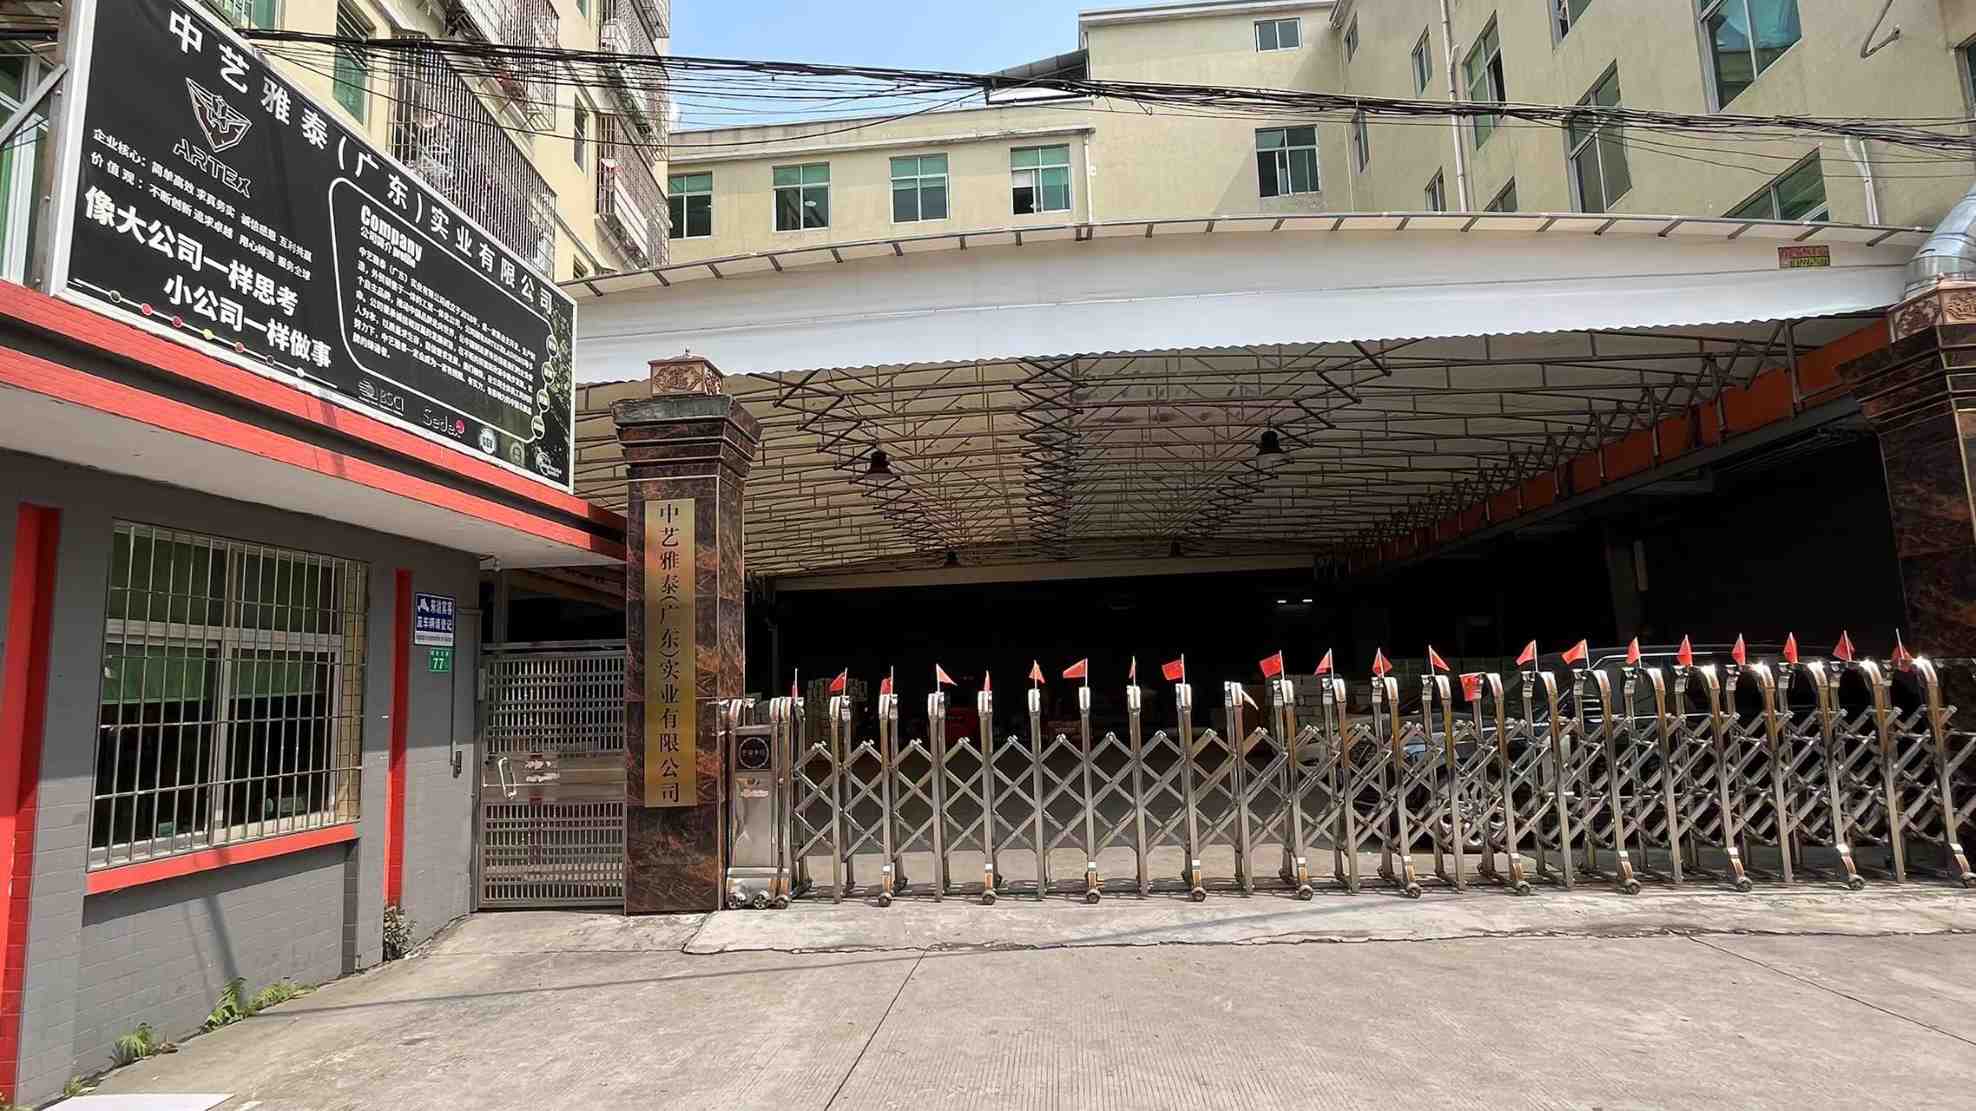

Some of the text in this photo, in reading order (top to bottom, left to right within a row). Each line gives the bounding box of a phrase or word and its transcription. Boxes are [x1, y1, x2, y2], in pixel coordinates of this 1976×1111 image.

[169, 10, 552, 314] 中艺雅泰（广东）实业有限公司
[85, 185, 298, 316] 像大公司一样思考
[361, 204, 422, 262] Company
[163, 275, 332, 368] 小公司一样做事
[432, 657, 444, 670] 77
